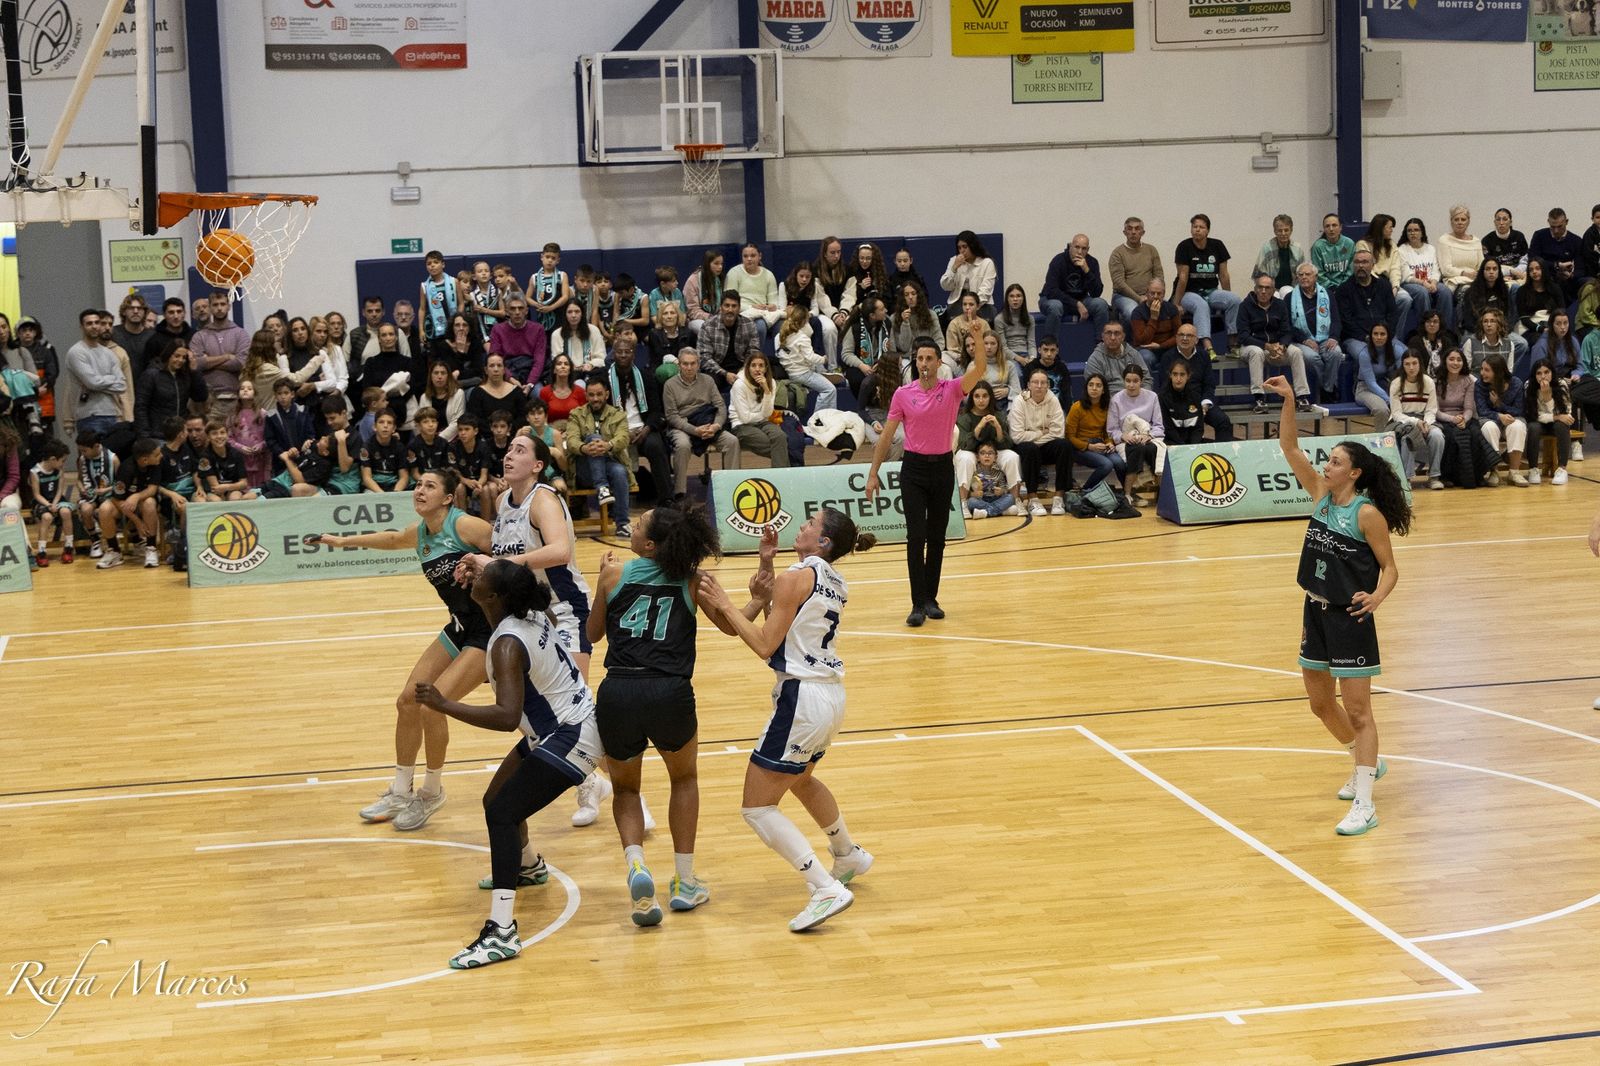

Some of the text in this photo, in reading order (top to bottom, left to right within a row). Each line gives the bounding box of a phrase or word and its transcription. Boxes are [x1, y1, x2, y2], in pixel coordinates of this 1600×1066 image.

[767, 1, 825, 18] MARCA
[857, 1, 914, 18] MARCA
[1030, 7, 1123, 17] NUEVO SEMINUEVO
[1189, 7, 1237, 16] JARDINES
[1248, 3, 1291, 13] PISCINAS
[130, 19, 168, 33] Ant
[963, 21, 1009, 30] RENAULT
[1030, 19, 1066, 28] OCASIÓN
[73, 22, 83, 49] AGENCY
[780, 43, 810, 52] MÁLAGA
[870, 43, 899, 52] MÁLAGA
[1566, 45, 1588, 54] PISTA
[53, 47, 75, 70] SPORTS
[1046, 56, 1070, 65] PISTA
[1034, 69, 1082, 79] LEONARDO
[1537, 70, 1600, 81] CONTRERAS ESP
[1023, 83, 1056, 92] TORRES
[1190, 486, 1244, 506] ESTEPONA
[333, 503, 394, 526] CAB
[202, 550, 265, 571] ESTEPONA
[297, 555, 420, 569] www.baloncestoestepona.
[1315, 558, 1327, 581] 12
[619, 594, 675, 641] 41
[821, 609, 840, 650] 7
